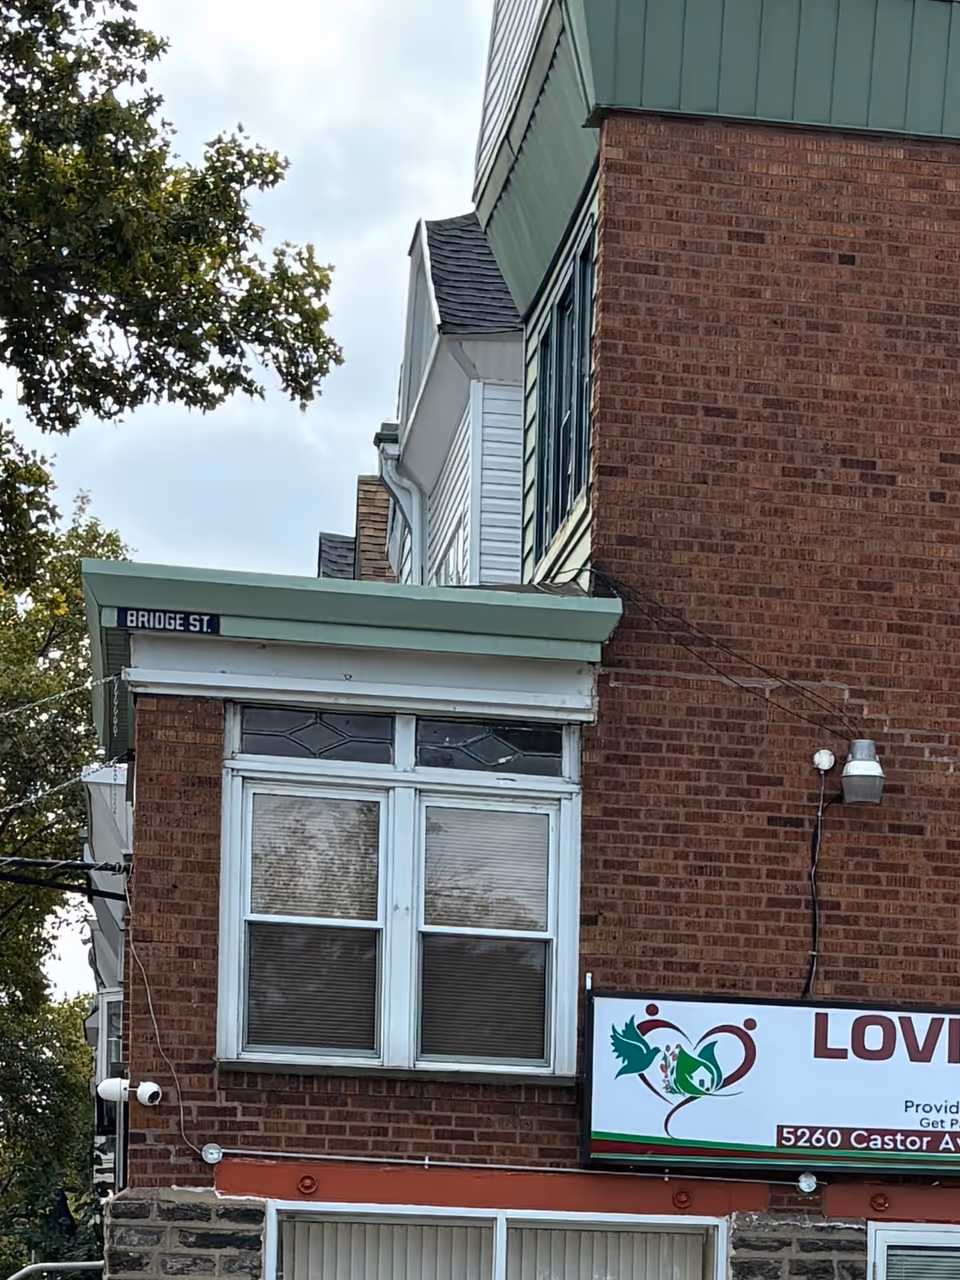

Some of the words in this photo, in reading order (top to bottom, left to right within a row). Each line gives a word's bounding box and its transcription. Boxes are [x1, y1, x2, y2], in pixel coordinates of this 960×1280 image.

[127, 610, 184, 630] BRIDGE
[920, 1118, 945, 1129] Get
[781, 1127, 842, 1148] 5260
[850, 1130, 931, 1150] Castor
